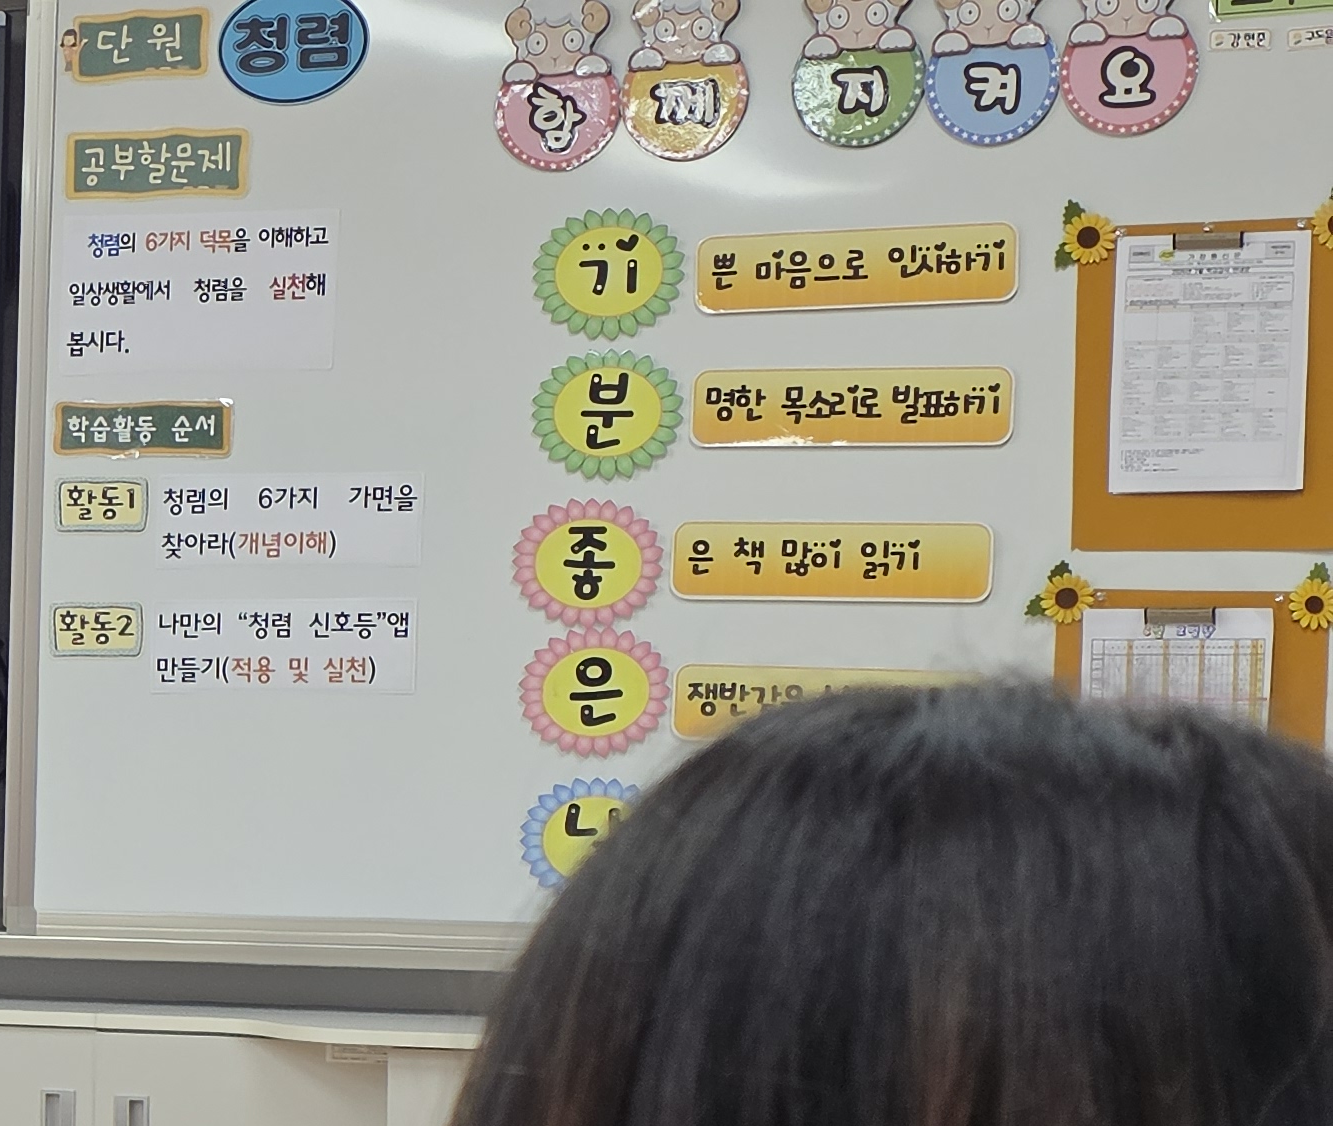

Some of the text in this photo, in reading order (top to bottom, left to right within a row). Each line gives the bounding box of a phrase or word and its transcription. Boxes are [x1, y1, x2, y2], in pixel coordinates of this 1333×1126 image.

[234, 8, 352, 75] 청렴
[81, 140, 232, 186] 공부할문제
[88, 225, 329, 258] 청렴의 6가지 덕목을 이해하고
[711, 253, 738, 290] 쁜
[754, 249, 869, 290] 마음으로
[887, 239, 1007, 279] 인사하기
[69, 273, 328, 307] 일상생활에서 청렴을 실천해
[66, 329, 131, 357] 봅시다.
[580, 371, 1002, 450] 분 명한 목소리로 발표하기
[67, 413, 217, 446] 학습활동 순서
[65, 485, 137, 521] 활동1
[258, 485, 319, 510] 6가지
[348, 483, 418, 513] 가면을
[161, 530, 337, 559] 찾아라(개념이해)
[563, 525, 922, 601] 좋 은 책 많이 읽기
[58, 612, 135, 647] 활동2
[158, 611, 222, 639] 나만의
[155, 655, 378, 685] 만들기(적용 및 실천)
[569, 656, 623, 727] 은
